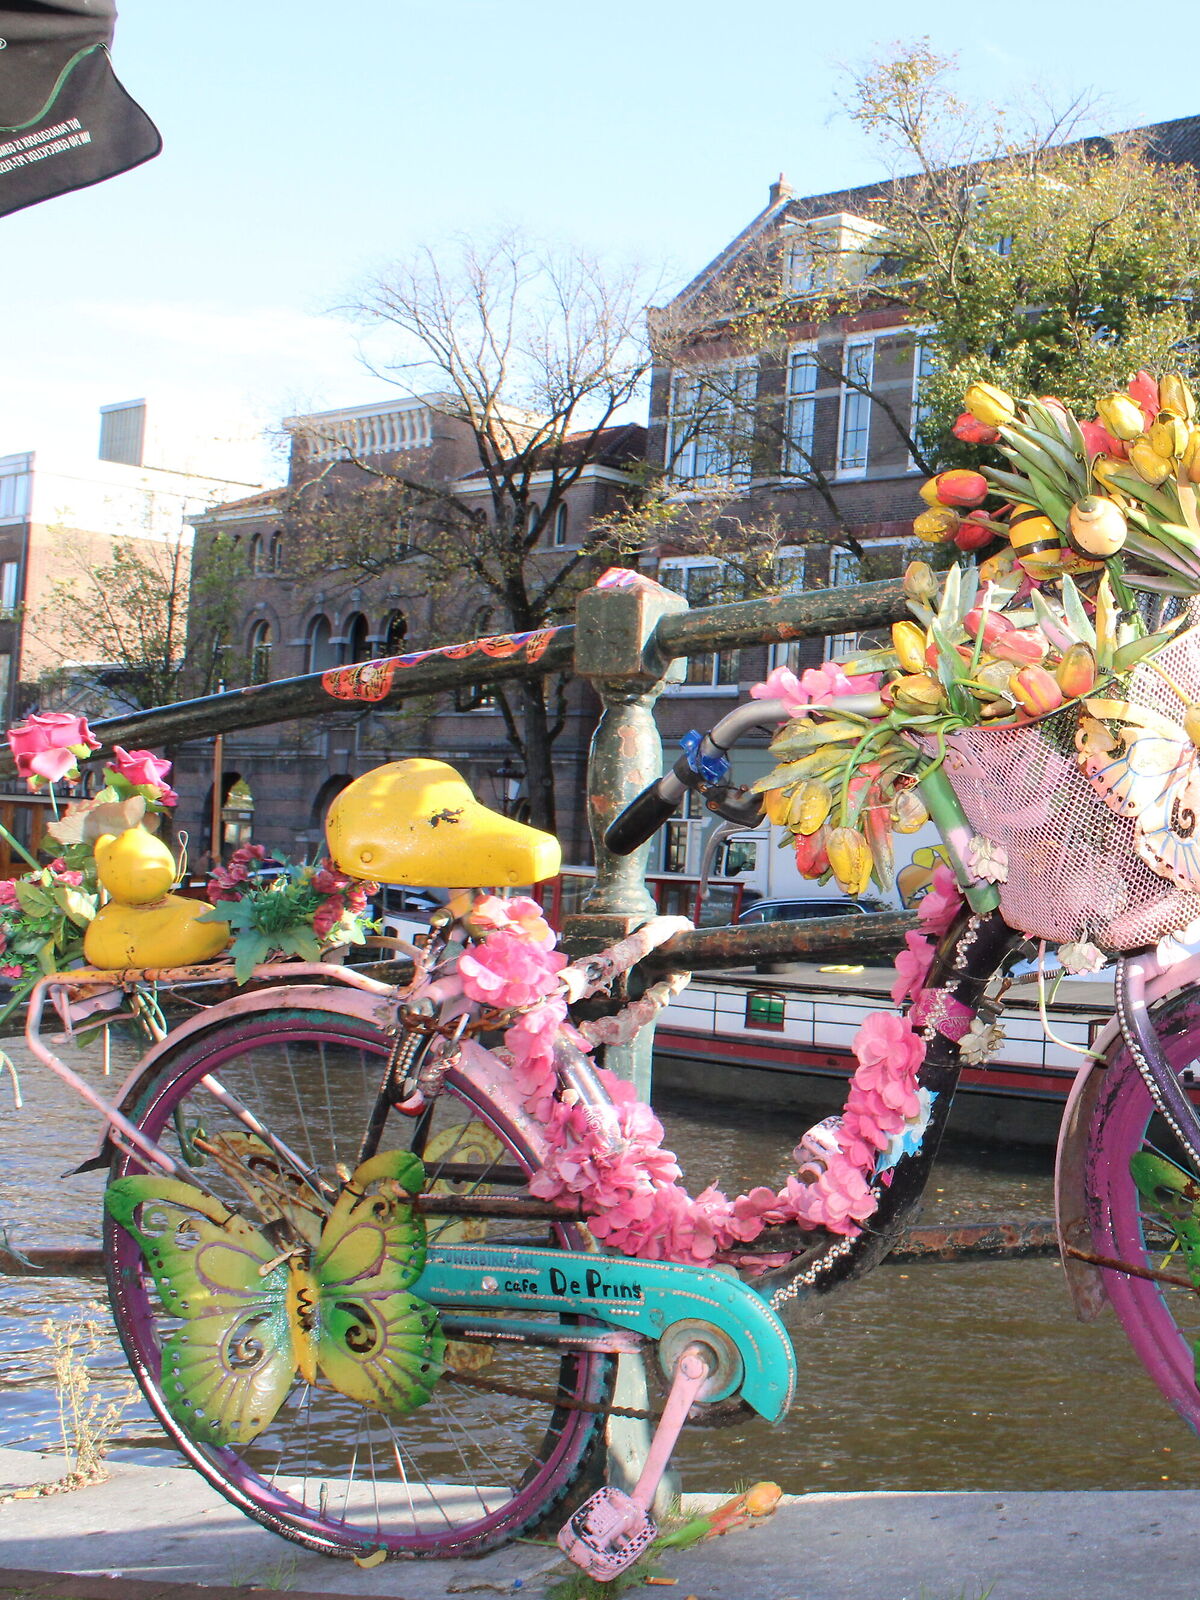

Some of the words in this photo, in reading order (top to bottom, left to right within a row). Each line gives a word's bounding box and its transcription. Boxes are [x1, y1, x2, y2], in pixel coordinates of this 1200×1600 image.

[504, 1279, 538, 1294] cafe
[549, 1267, 582, 1296] De
[586, 1268, 642, 1299] Prins
